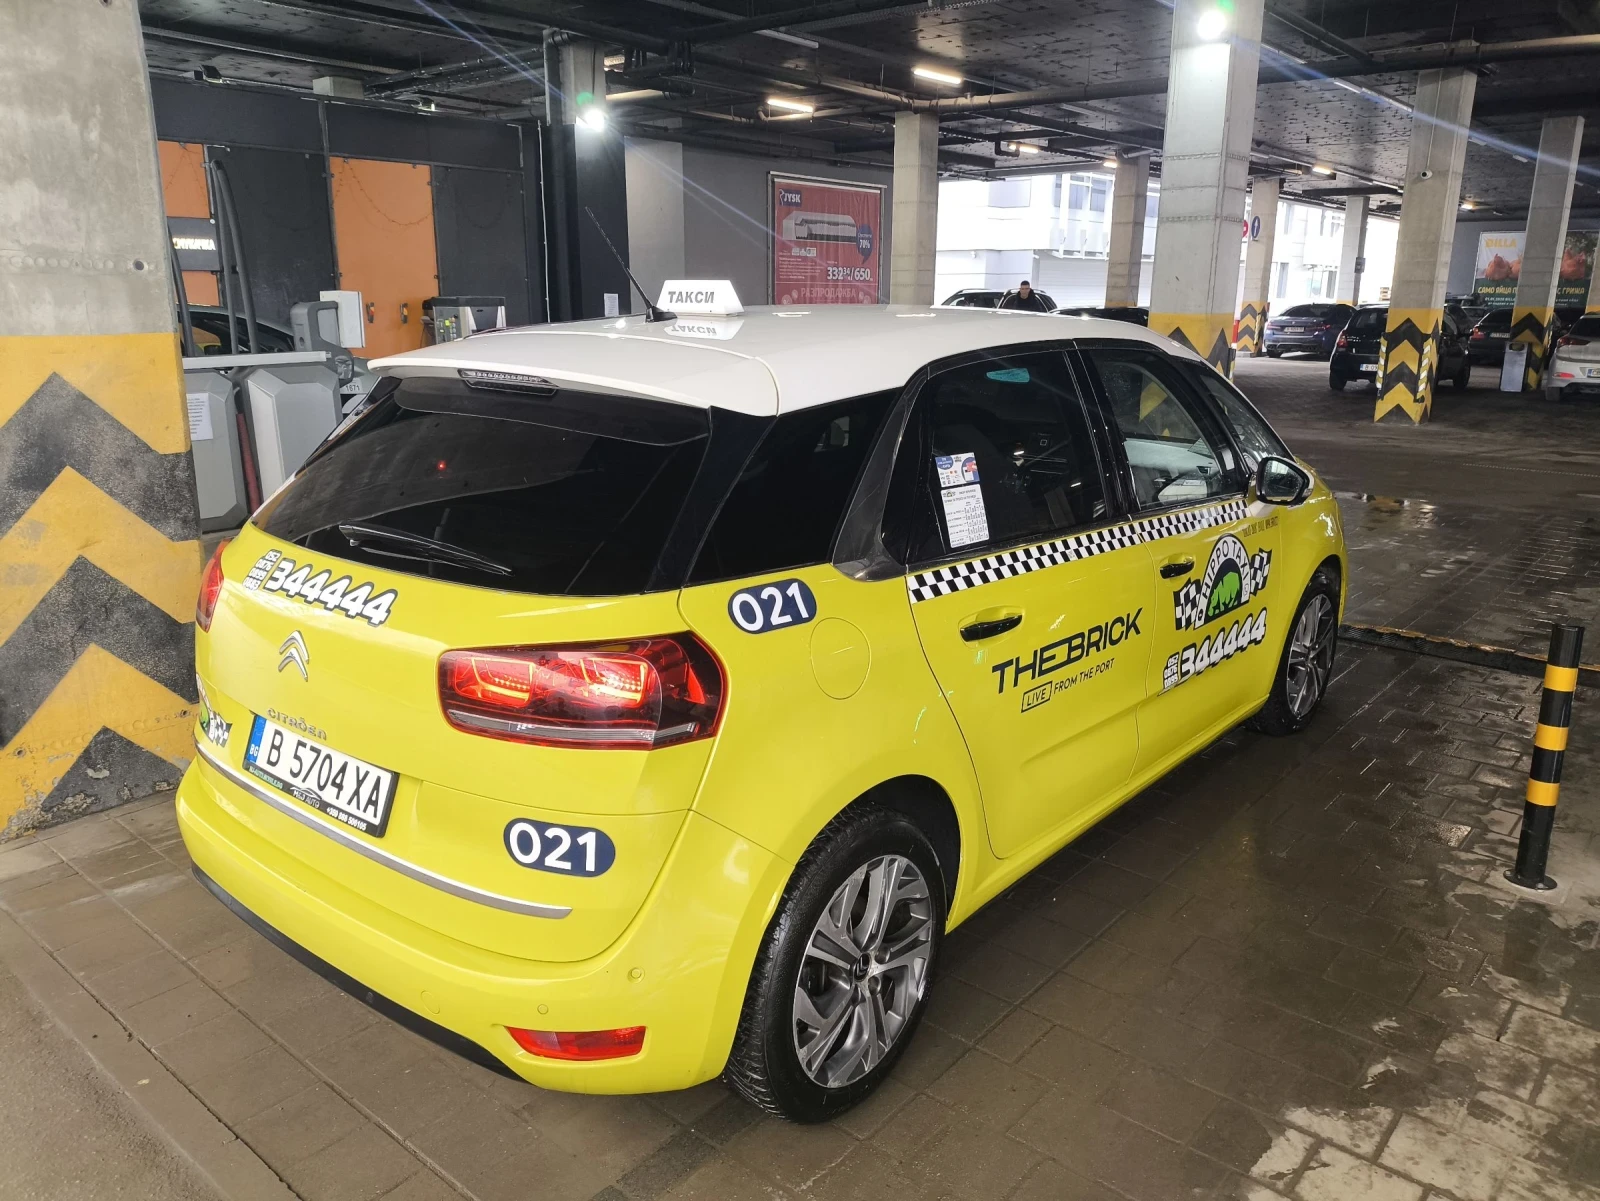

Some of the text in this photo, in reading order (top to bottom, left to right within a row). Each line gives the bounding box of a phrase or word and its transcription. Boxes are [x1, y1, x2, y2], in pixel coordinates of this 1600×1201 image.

[783, 193, 801, 202] JYSK
[860, 240, 870, 248] 70%
[1485, 238, 1517, 248] BILLA
[668, 291, 715, 304] ТАКСИ
[801, 287, 857, 298] РАЗПРОДАЖБА
[1478, 286, 1494, 294] САМО
[1495, 285, 1512, 294] ЯЙЦА
[1202, 539, 1249, 600] HIPPO TAXI
[265, 560, 396, 625] 344444
[732, 582, 810, 631] 021
[1181, 608, 1267, 680] 344444
[1054, 658, 1115, 695] FROM THE PORT
[1026, 687, 1048, 707] LIVE
[267, 729, 381, 818] B 5704 XA
[305, 796, 320, 809] AUTO
[509, 822, 597, 872] 021
